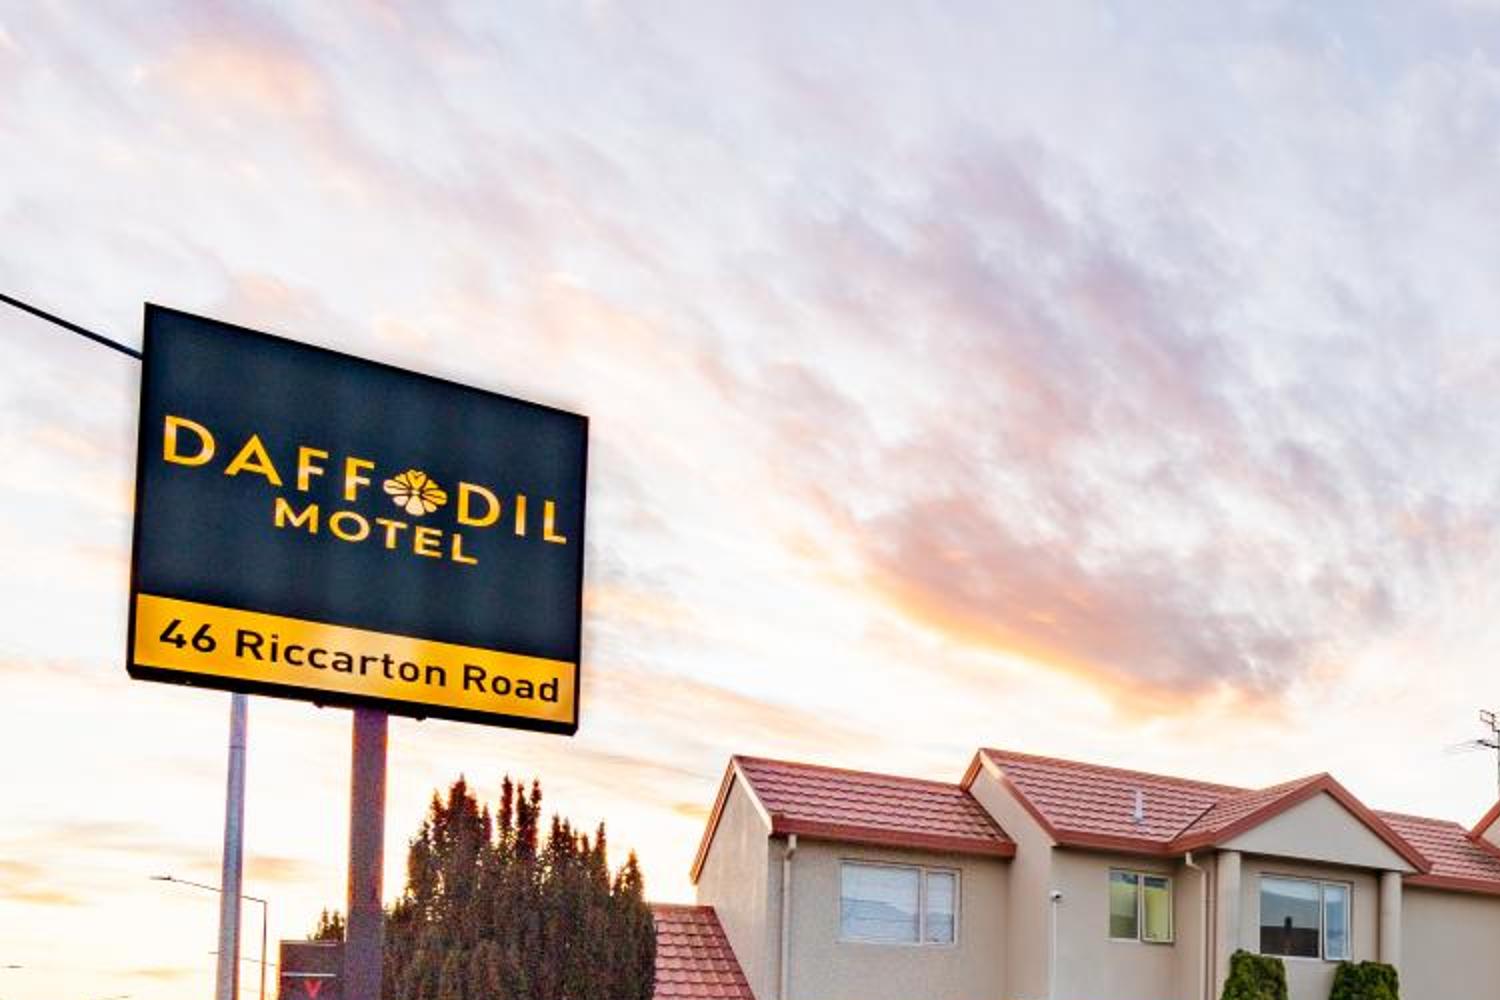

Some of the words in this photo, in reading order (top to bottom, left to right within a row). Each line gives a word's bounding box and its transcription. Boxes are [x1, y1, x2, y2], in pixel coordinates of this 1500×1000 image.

[273, 497, 479, 565] MOTEL
[159, 618, 218, 654] 46
[235, 629, 447, 687] Riccarton
[462, 665, 560, 703] Road
